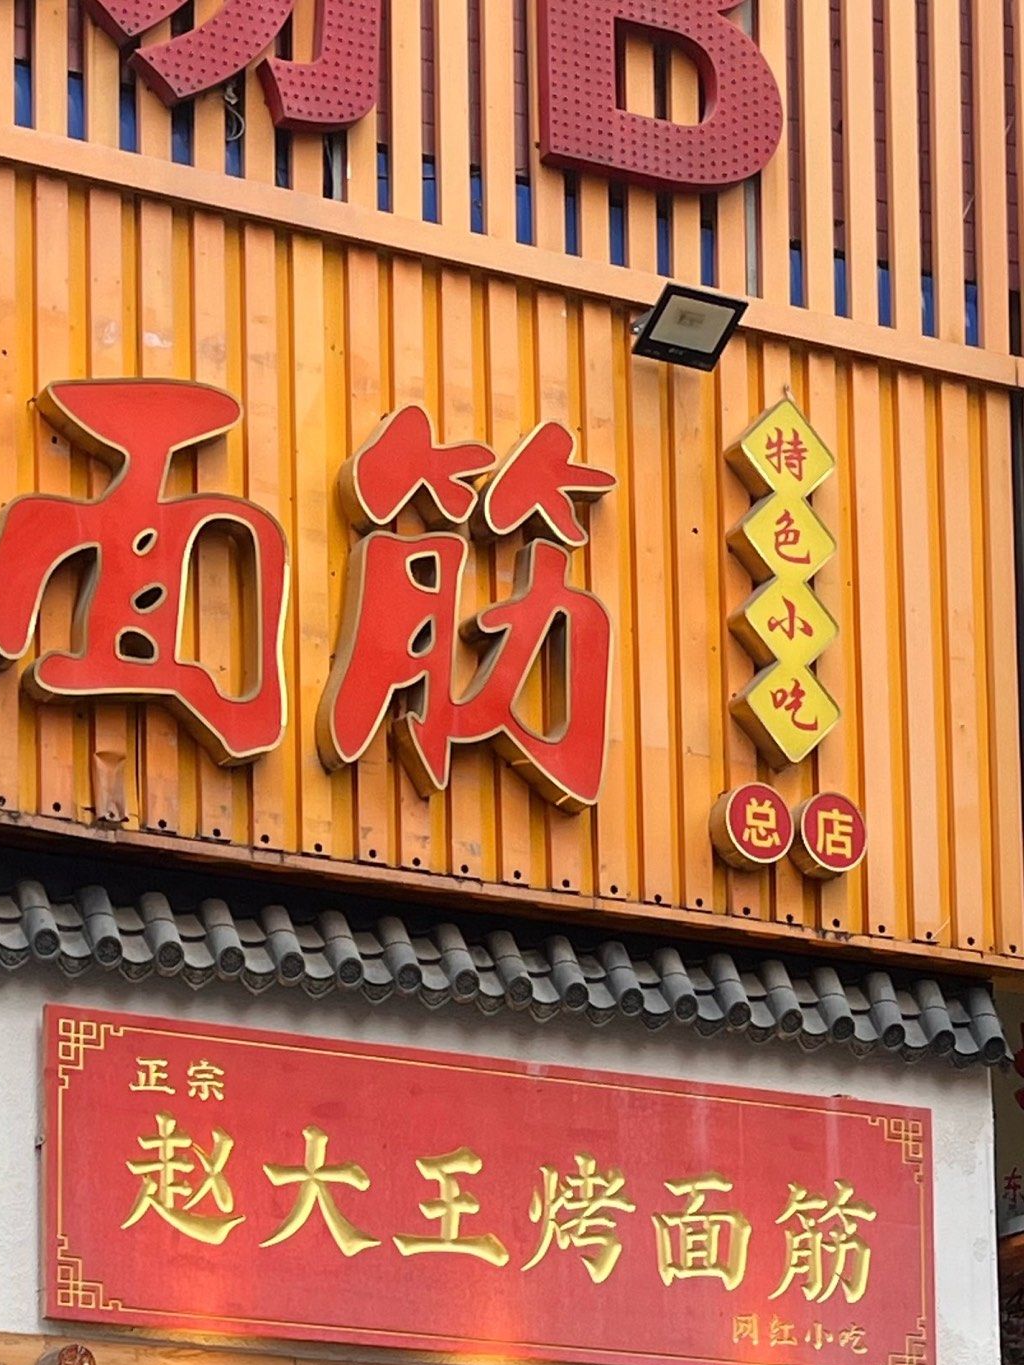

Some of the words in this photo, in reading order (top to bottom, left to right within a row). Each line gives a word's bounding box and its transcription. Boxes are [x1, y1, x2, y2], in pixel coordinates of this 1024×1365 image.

[763, 427, 819, 733] 特色小吃
[742, 798, 853, 852] 总店
[129, 1056, 225, 1101] 正宗
[120, 1110, 877, 1304] 赵大王烤面筋
[731, 1313, 869, 1354] 网红小吃
